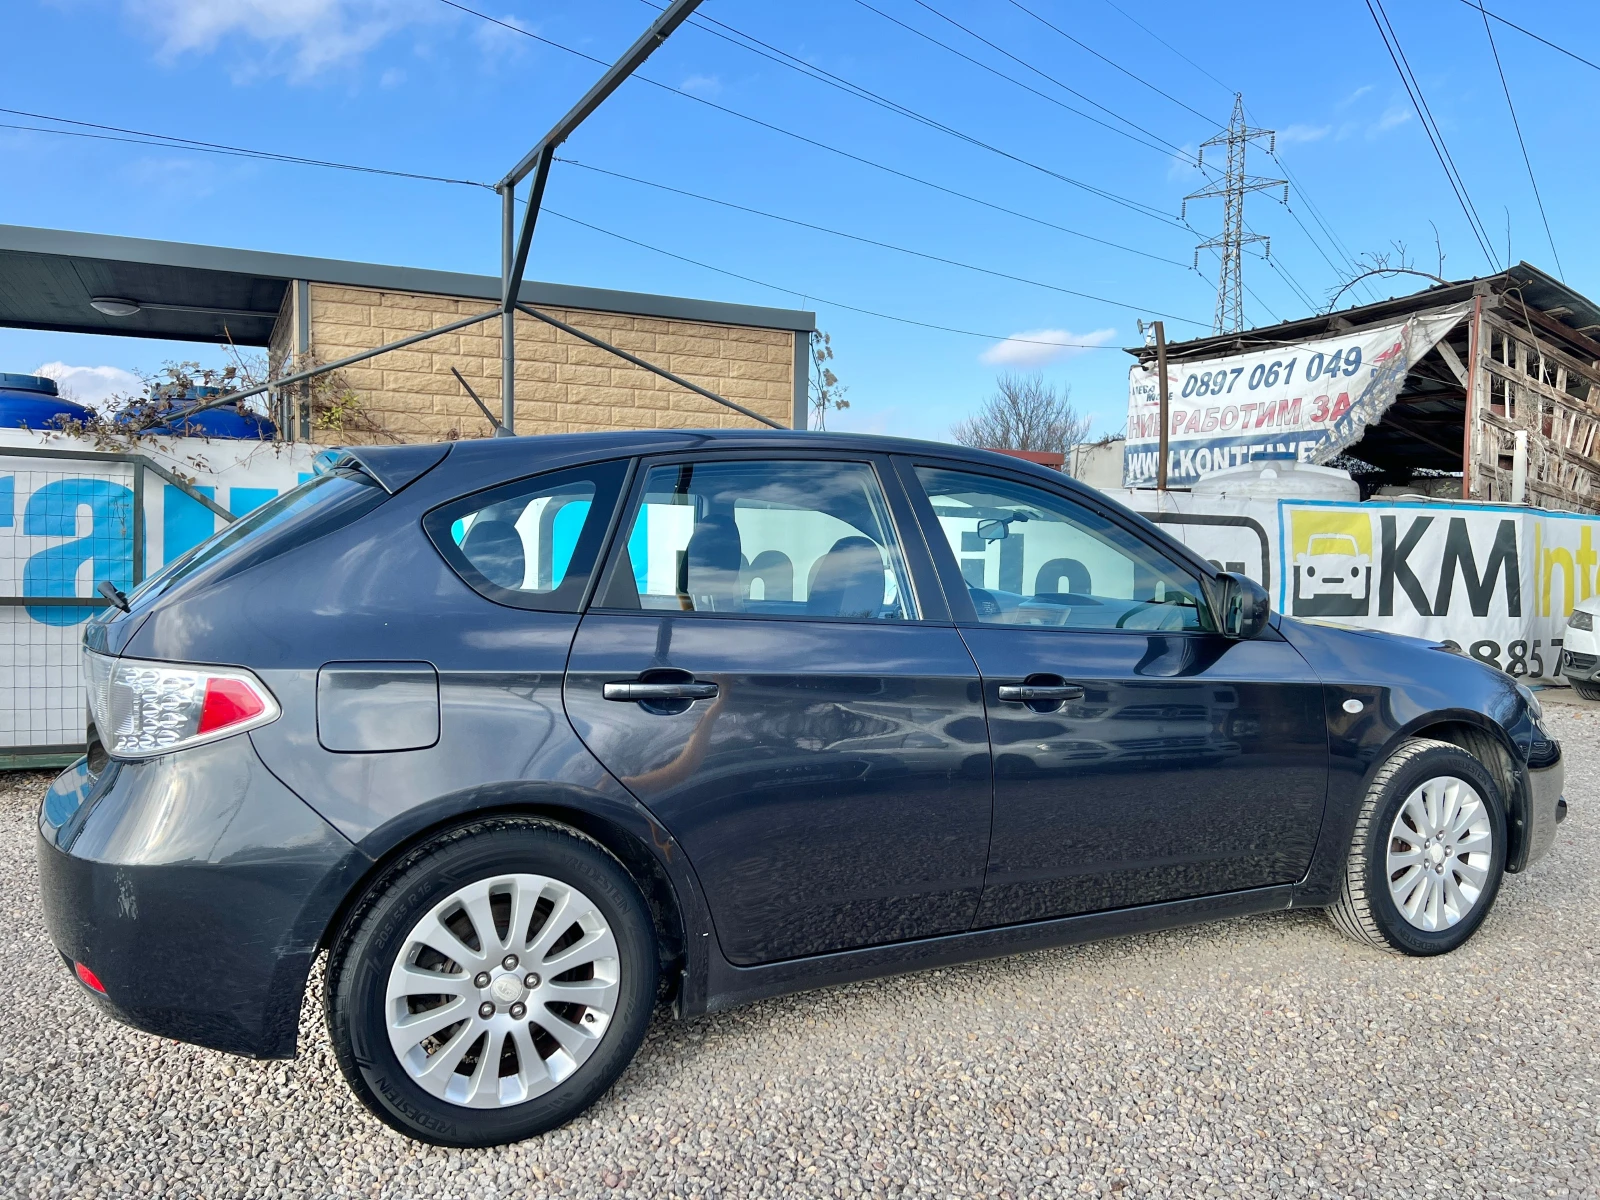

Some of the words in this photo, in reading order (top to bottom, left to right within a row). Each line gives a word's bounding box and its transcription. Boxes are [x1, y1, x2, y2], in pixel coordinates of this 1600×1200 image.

[1182, 367, 1244, 398] 0897
[1248, 357, 1297, 390] 061
[1305, 346, 1362, 382] 049
[1171, 397, 1302, 435] РАБОТИМ
[1310, 392, 1350, 423] ЗА
[1378, 515, 1521, 617] KM
[1534, 522, 1600, 617] Int
[1440, 639, 1563, 679] 8857
[375, 903, 408, 950] 205/55
[408, 893, 419, 906] R
[418, 881, 432, 896] 16
[375, 1076, 457, 1137] VREDESTEIN
